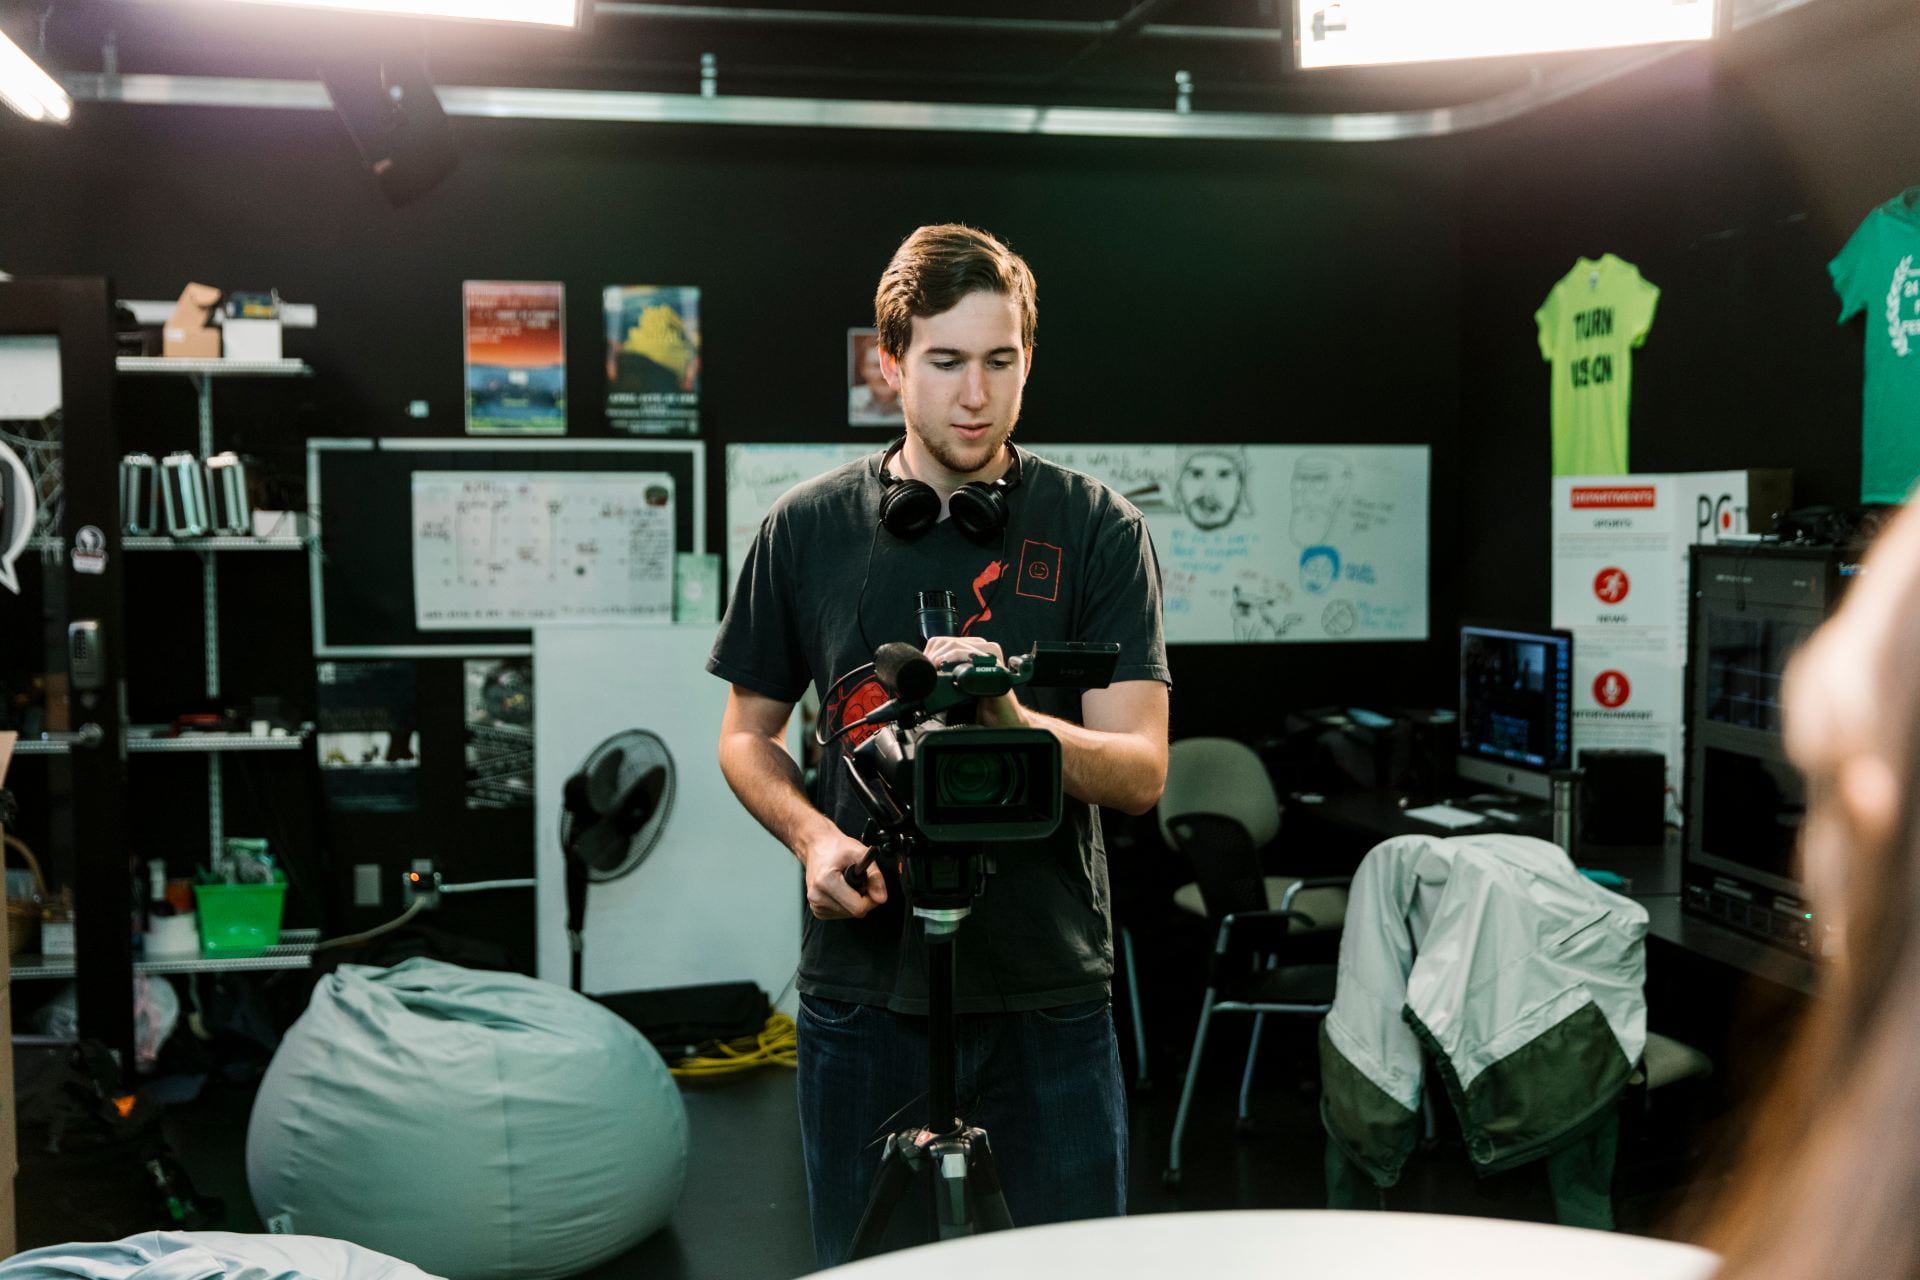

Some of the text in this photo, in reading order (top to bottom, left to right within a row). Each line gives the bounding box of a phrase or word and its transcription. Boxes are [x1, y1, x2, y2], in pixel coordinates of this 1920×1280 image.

[1573, 307, 1613, 339] TURN
[1571, 354, 1613, 388] US ON
[1573, 488, 1653, 505] DEPARTMENTS
[1592, 517, 1632, 529] SPORTS
[1596, 613, 1628, 625] NEWS
[1572, 709, 1654, 721] NTERTAINMENT
